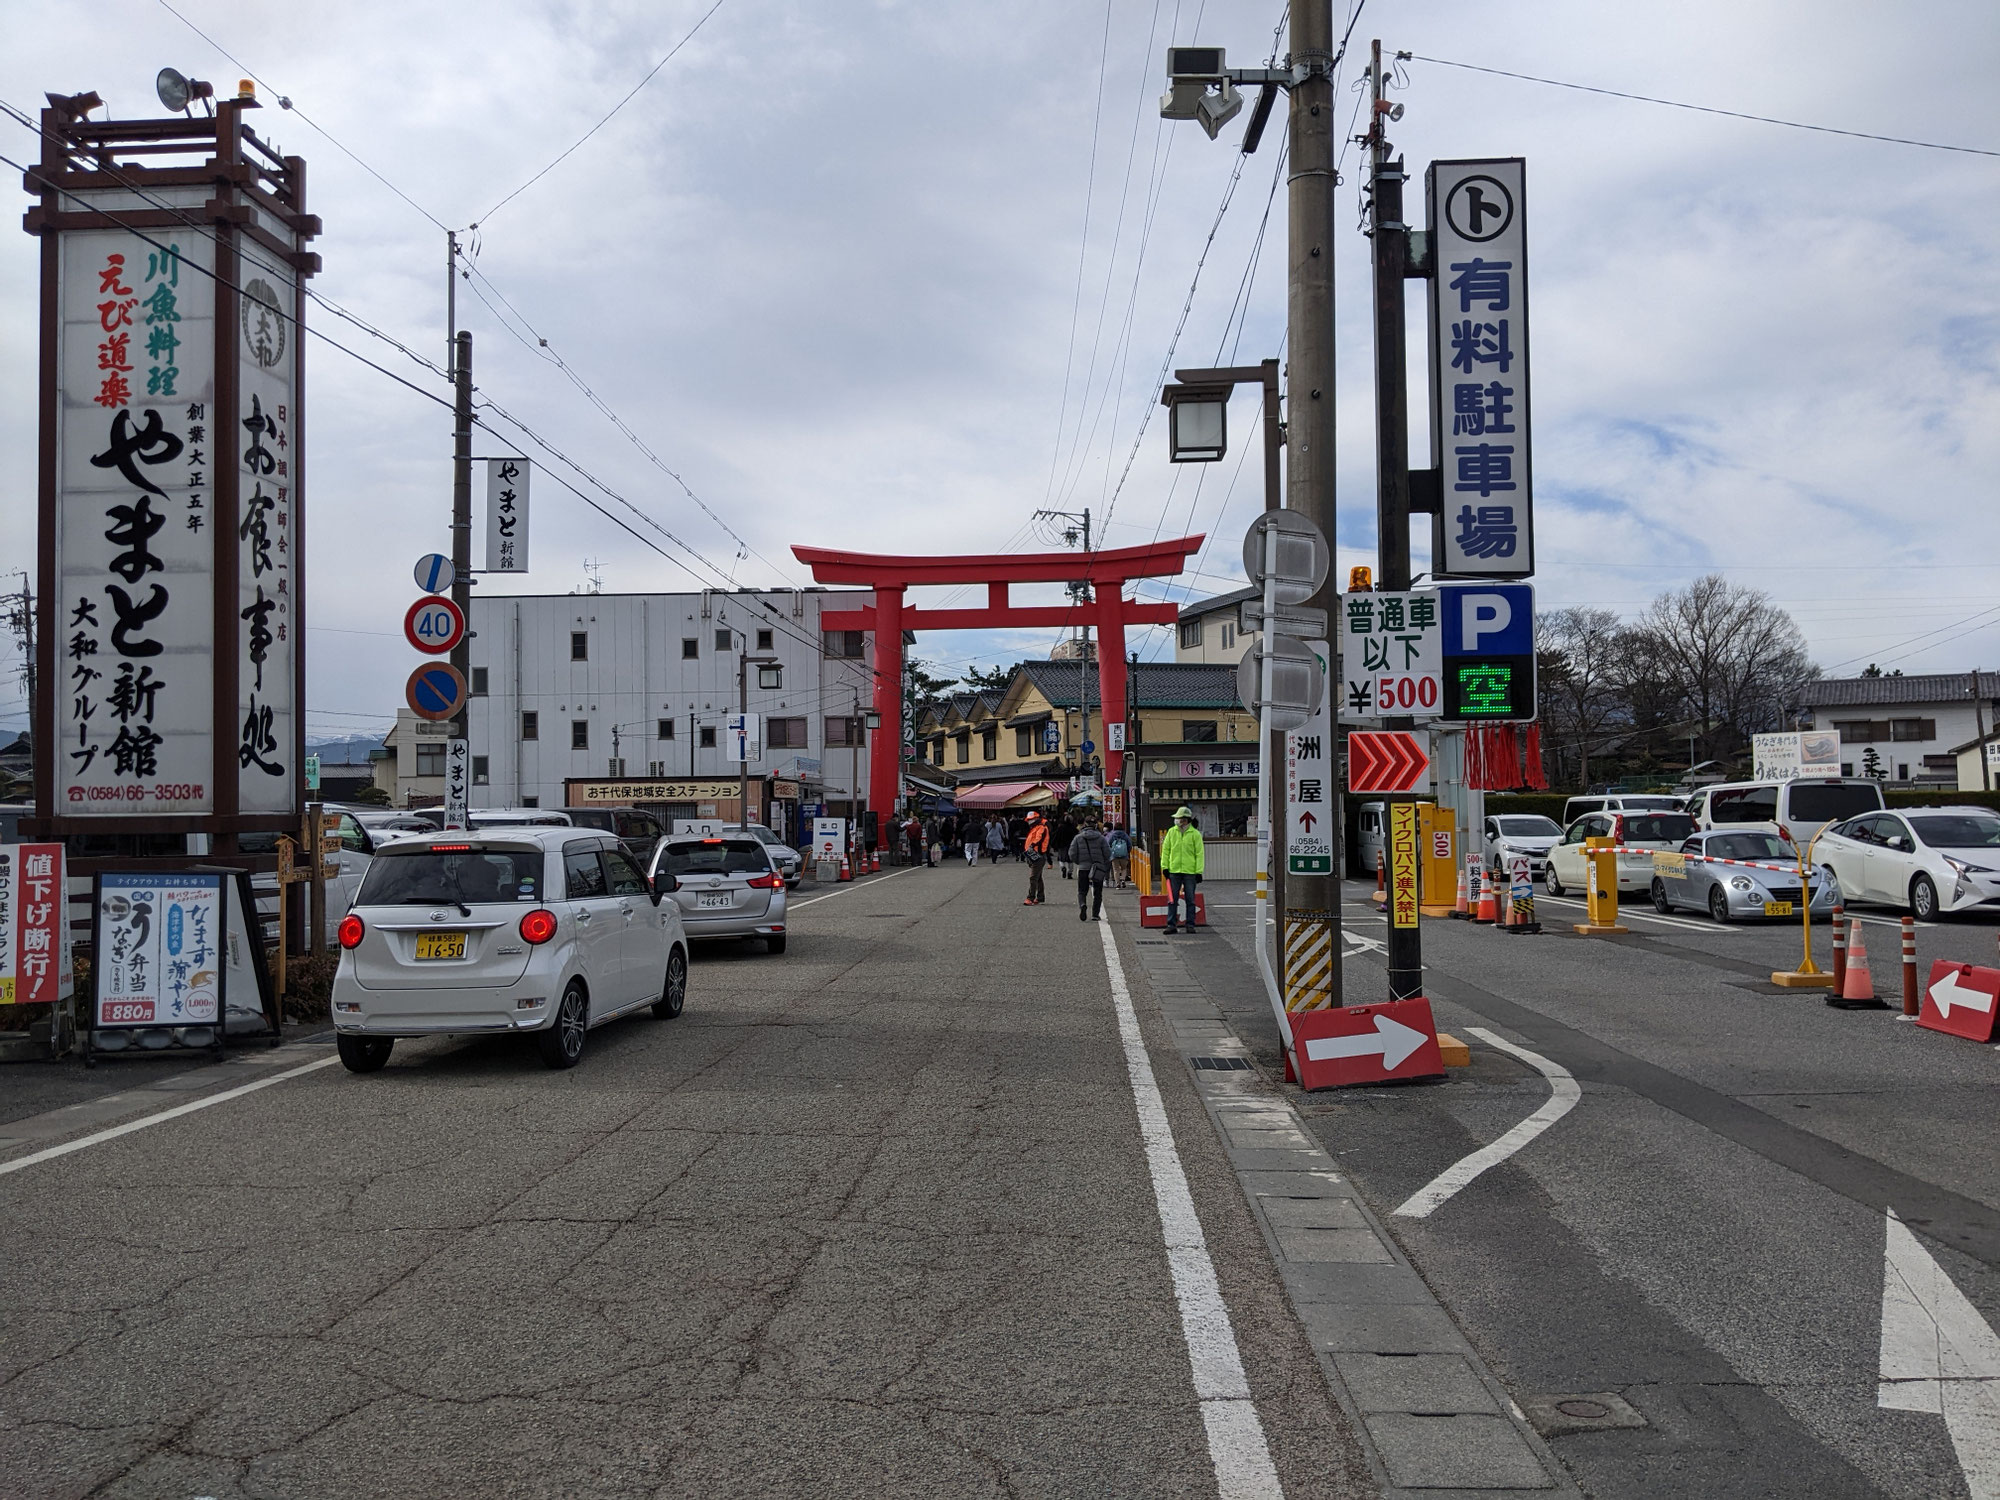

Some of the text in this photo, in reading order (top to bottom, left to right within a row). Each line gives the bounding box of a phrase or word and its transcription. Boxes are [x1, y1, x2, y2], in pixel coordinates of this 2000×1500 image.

[94, 254, 139, 409] えび道楽
[143, 243, 182, 396] 川魚料理
[254, 312, 272, 368] 大和
[1450, 257, 1518, 560] 有料駐車場
[186, 403, 206, 534] 創業大正五年
[498, 461, 520, 568] やまと新館
[90, 408, 184, 779] やまと新館
[240, 393, 285, 777] お食事処
[418, 612, 450, 638] 40
[1347, 597, 1437, 634] 普通車
[1461, 593, 1512, 650] P
[1363, 635, 1422, 671] 以下
[69, 596, 102, 777] 大和グループ
[1459, 664, 1512, 713] 空
[451, 743, 466, 799] やまと
[588, 785, 742, 799] お千代保地域安全ステーション
[1290, 845, 1330, 854] 66-2245
[1394, 805, 1415, 925] マイクロバス進入禁止
[1435, 833, 1448, 857] 500
[1513, 857, 1531, 883] バス
[1470, 866, 1482, 901] 料金所
[427, 943, 464, 957] 16-50
[112, 1005, 152, 1020] 880円
